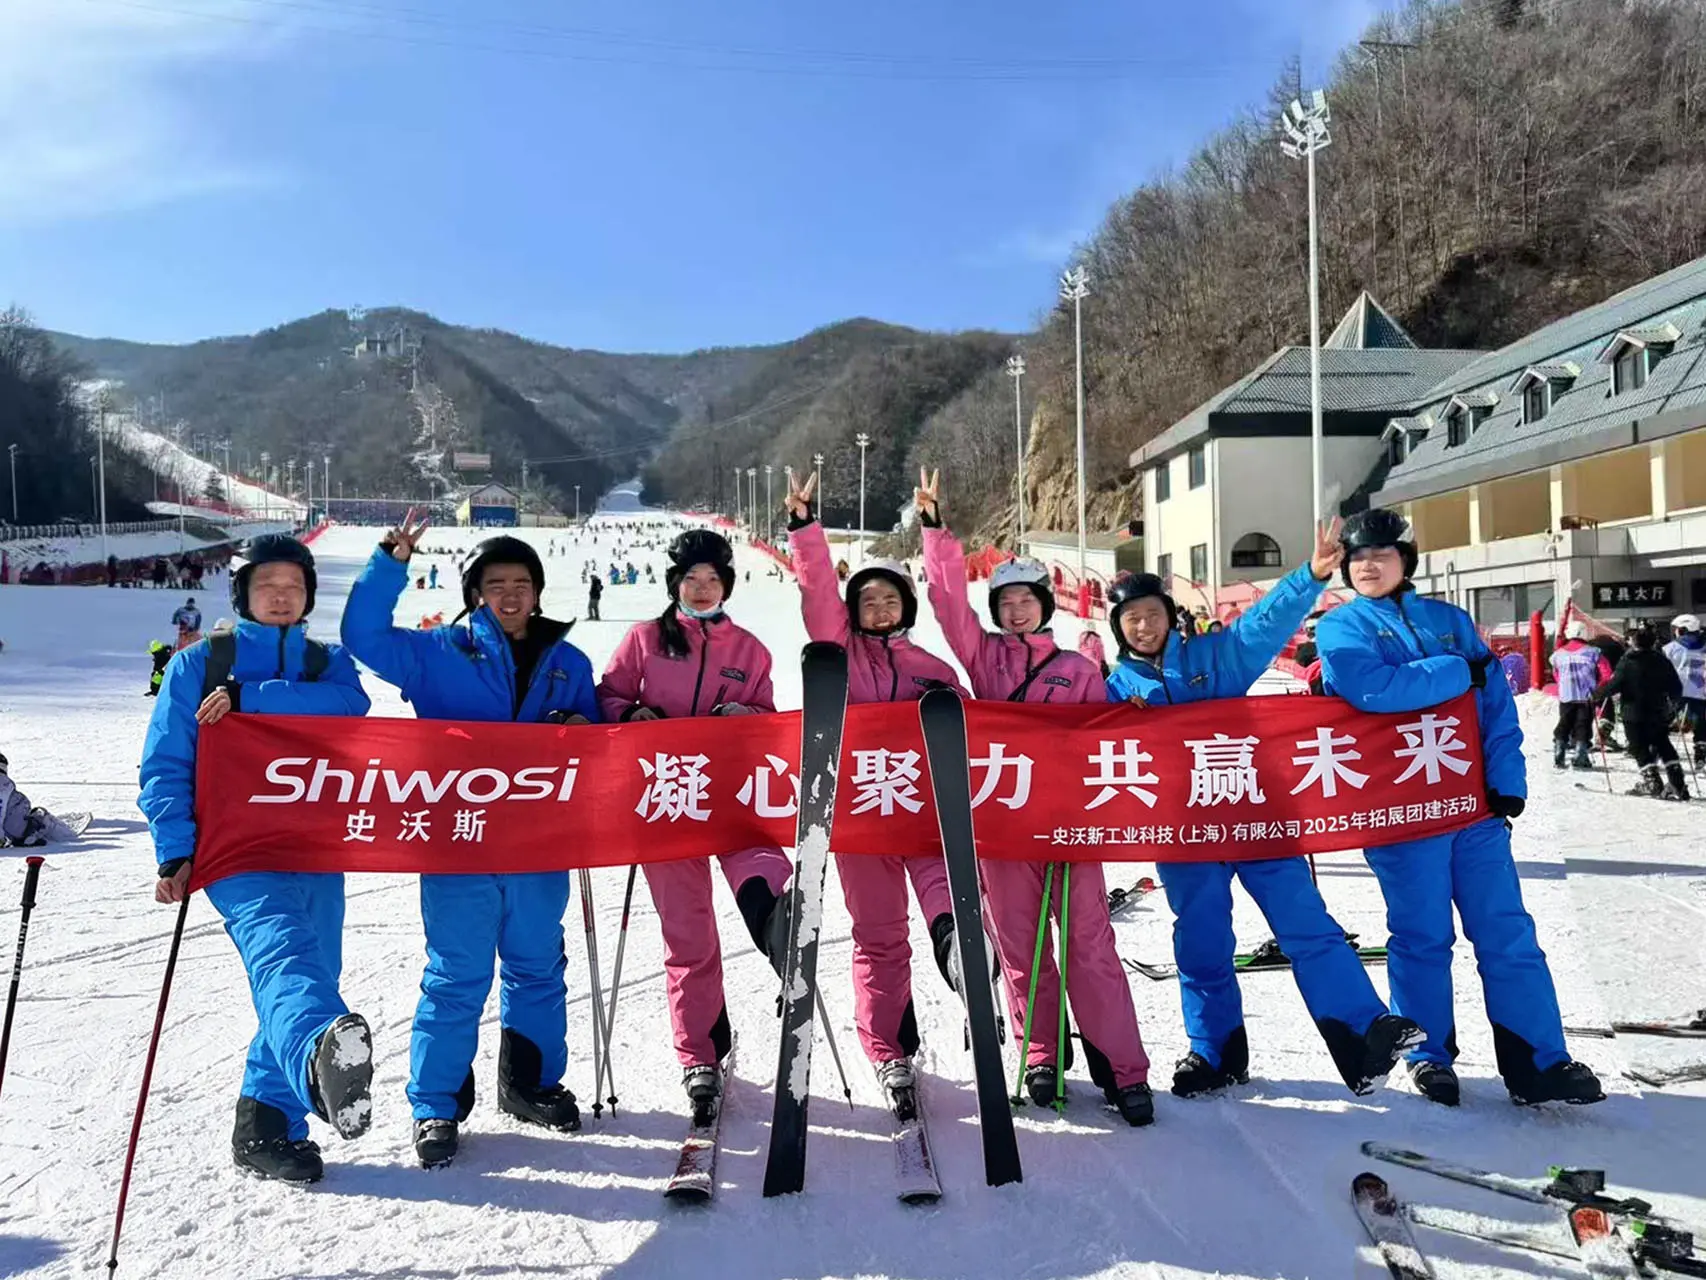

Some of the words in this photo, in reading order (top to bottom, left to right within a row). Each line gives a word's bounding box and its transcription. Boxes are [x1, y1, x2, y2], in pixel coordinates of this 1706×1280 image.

[1599, 586, 1665, 602] 雪具大厅
[248, 757, 580, 803] Shiwosi
[343, 809, 487, 842] 史沃斯
